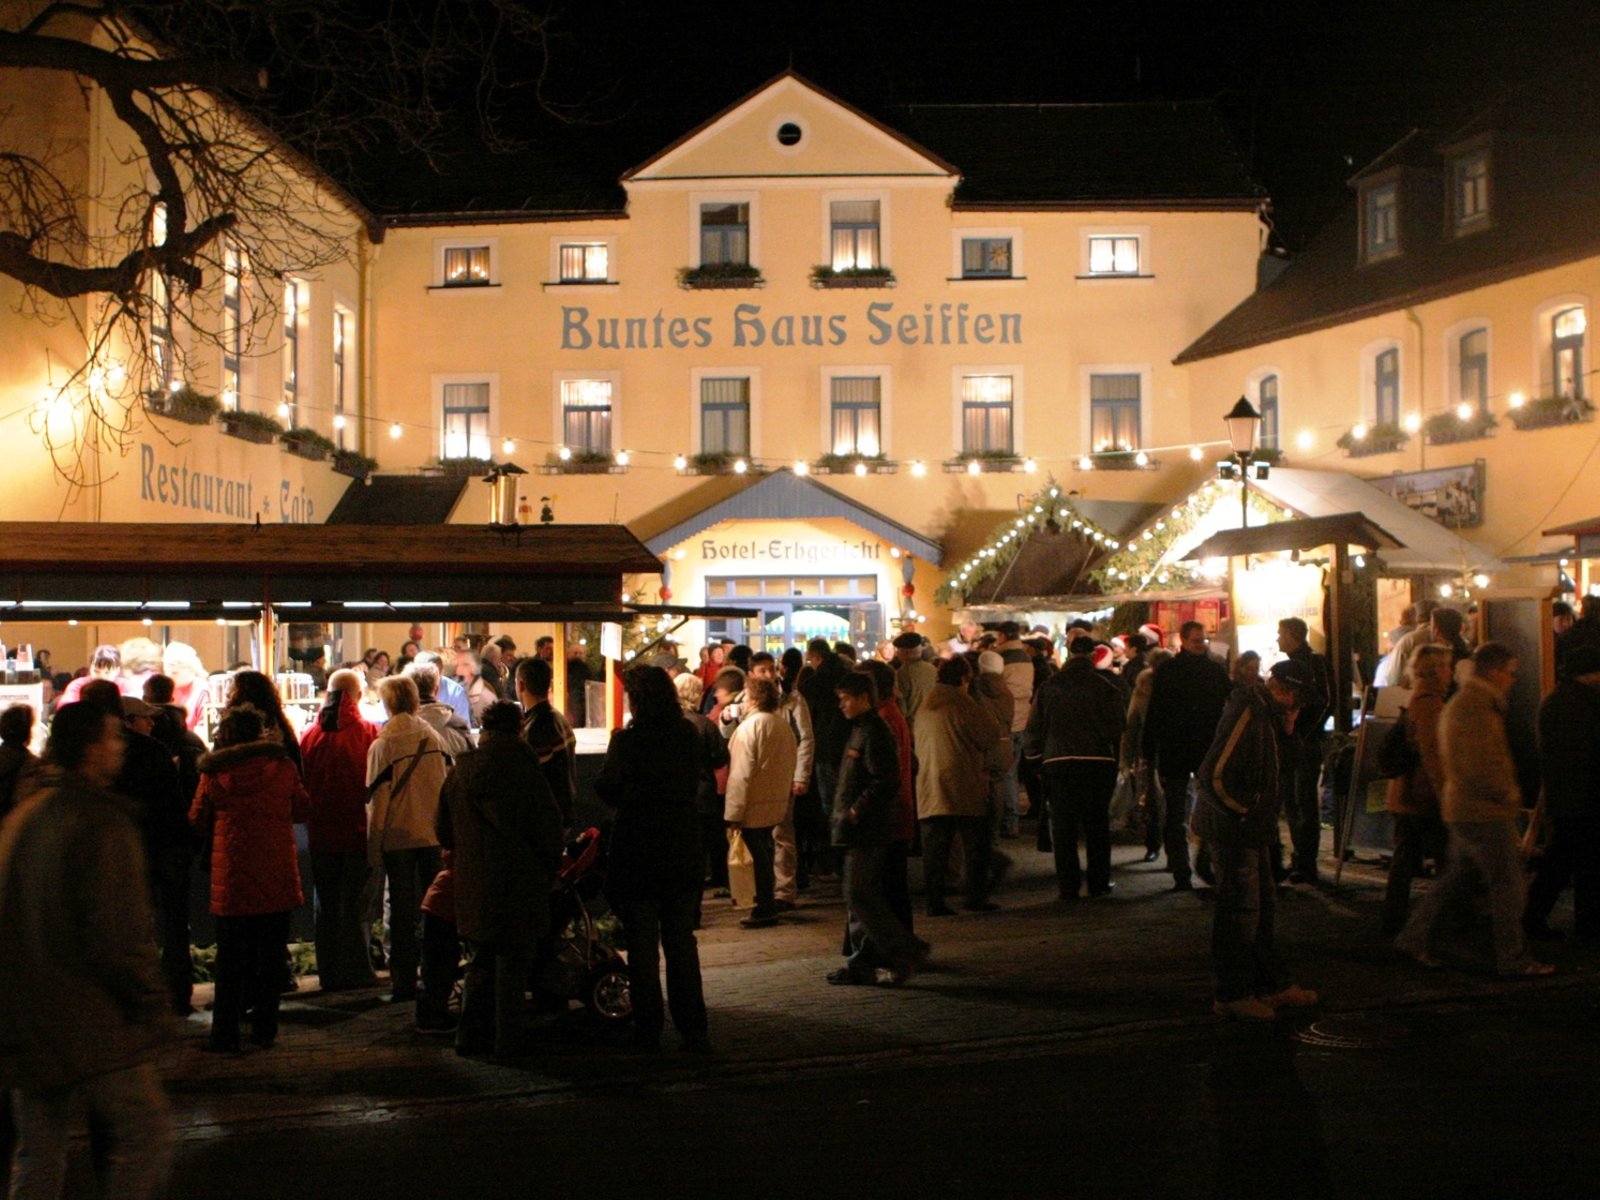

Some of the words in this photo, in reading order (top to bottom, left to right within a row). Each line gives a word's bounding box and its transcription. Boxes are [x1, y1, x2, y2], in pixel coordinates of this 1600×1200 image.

[560, 305, 713, 350] Buntes
[732, 303, 847, 347] Haus
[867, 301, 1023, 346] Seiffen
[140, 442, 253, 520] Restaurant
[701, 539, 881, 564] Hotel-Erbgericht
